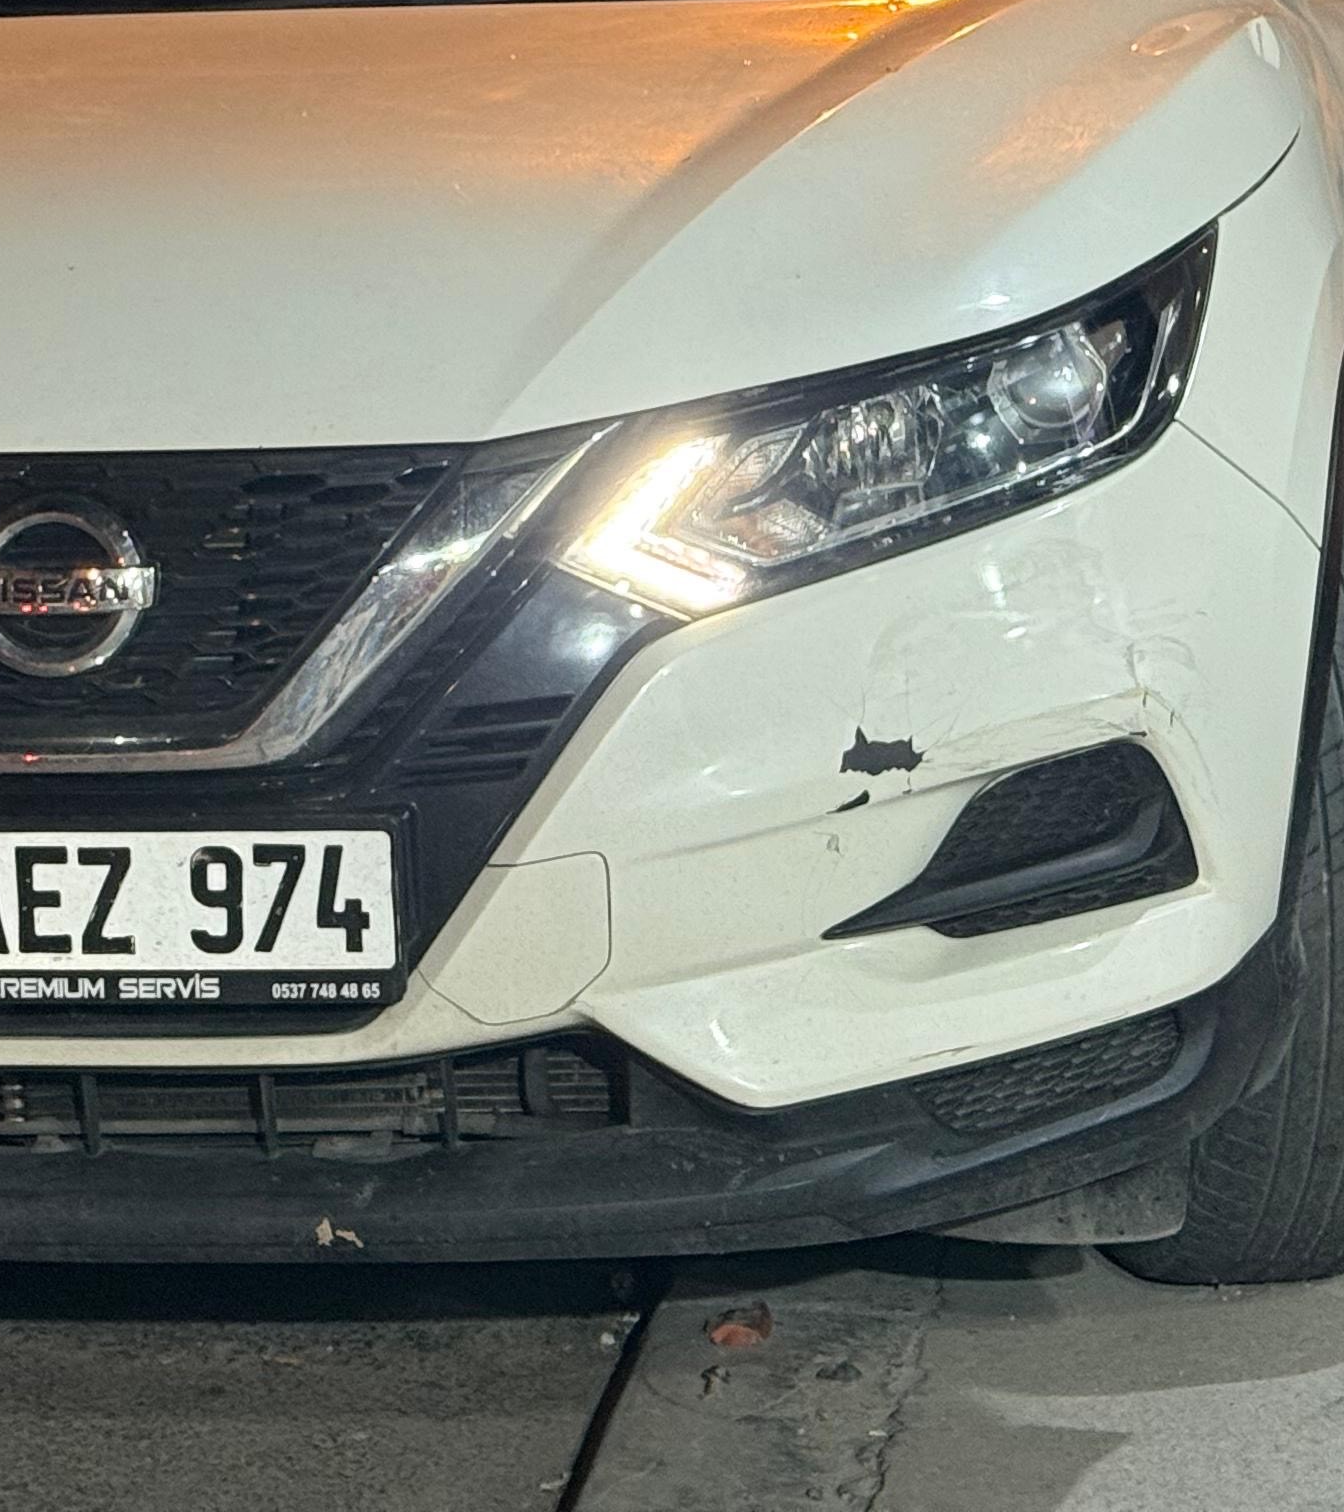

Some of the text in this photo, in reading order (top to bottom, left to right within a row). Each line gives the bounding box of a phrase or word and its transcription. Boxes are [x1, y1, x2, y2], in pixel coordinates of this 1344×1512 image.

[190, 843, 370, 954] 974
[118, 972, 221, 999] SERVİS
[272, 982, 380, 999] 0537 748 48 65
